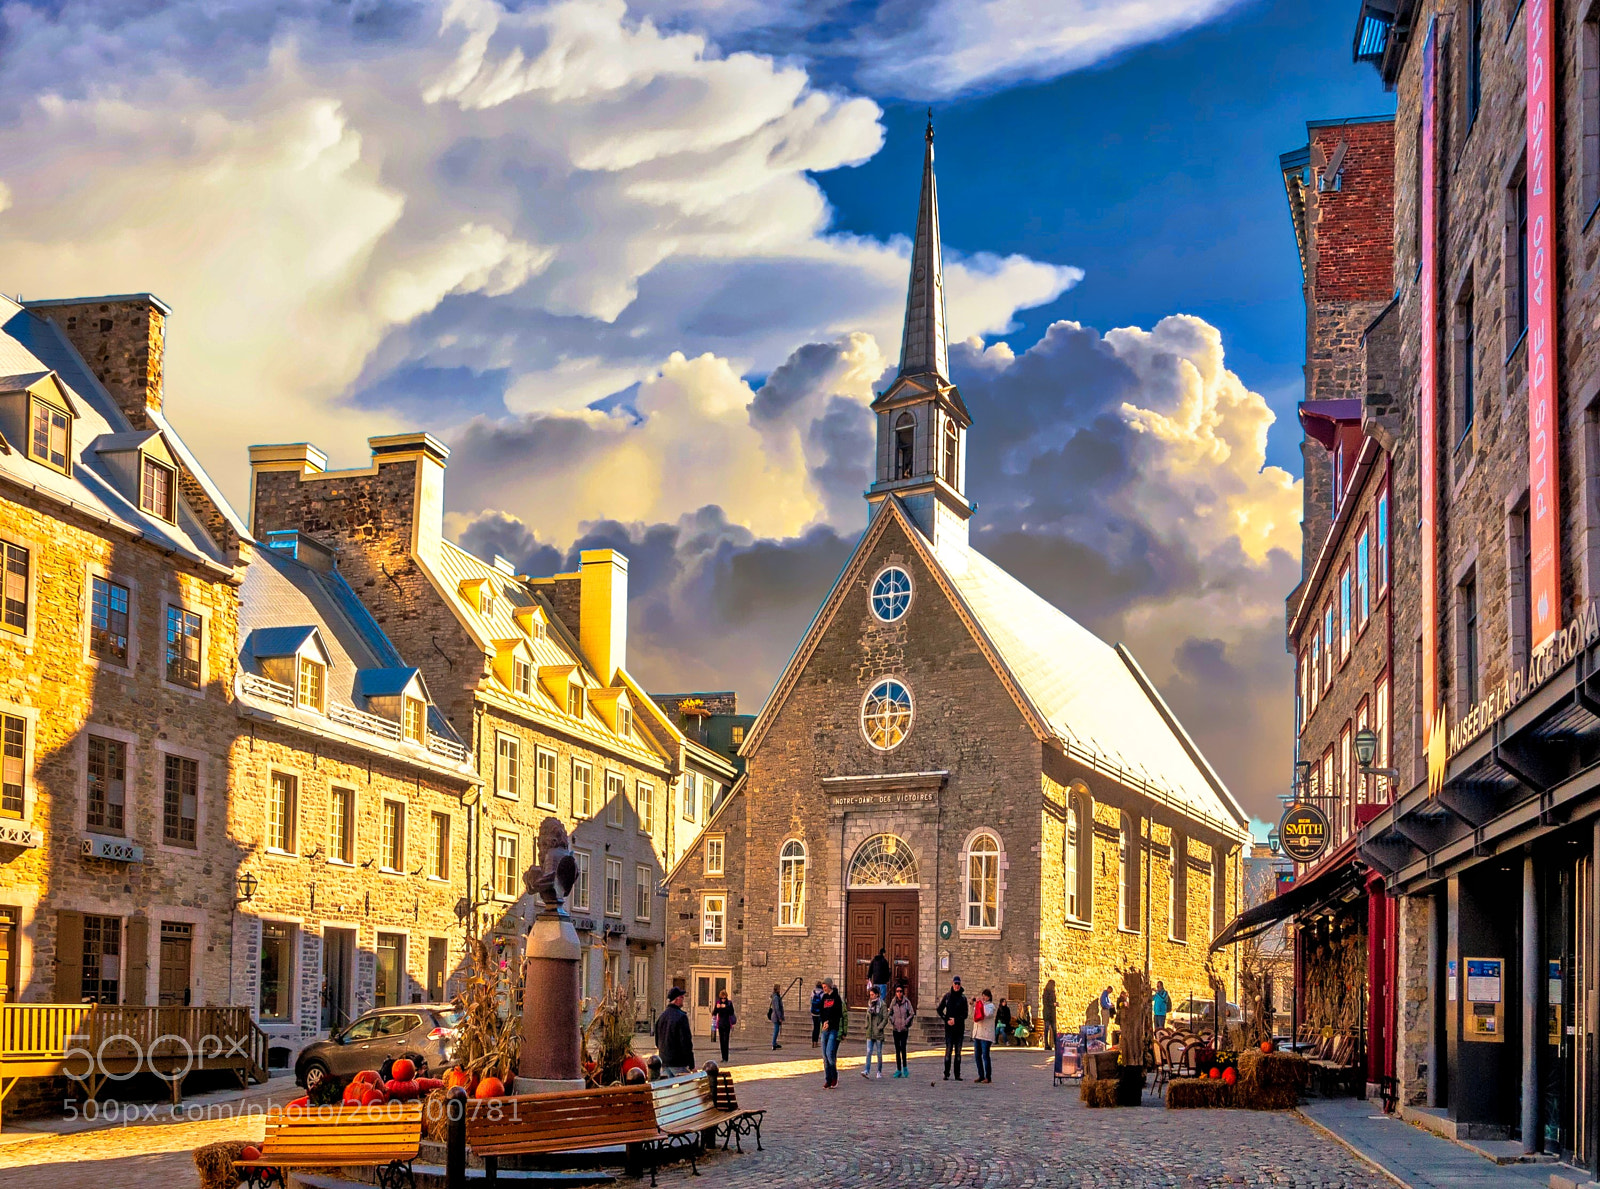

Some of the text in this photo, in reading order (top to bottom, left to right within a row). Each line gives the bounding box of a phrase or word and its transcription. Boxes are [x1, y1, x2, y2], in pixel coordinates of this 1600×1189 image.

[1532, 101, 1544, 195] ANS
[1533, 215, 1544, 306] 400
[1534, 319, 1545, 389] DE
[1535, 399, 1547, 521] PLUS
[1450, 703, 1480, 757] MUSÉE
[1481, 692, 1495, 733] DE
[1497, 679, 1511, 718] LA
[1511, 640, 1554, 705] PLACE
[896, 793, 933, 802] VICTOIRES
[1285, 823, 1323, 835] SMITH
